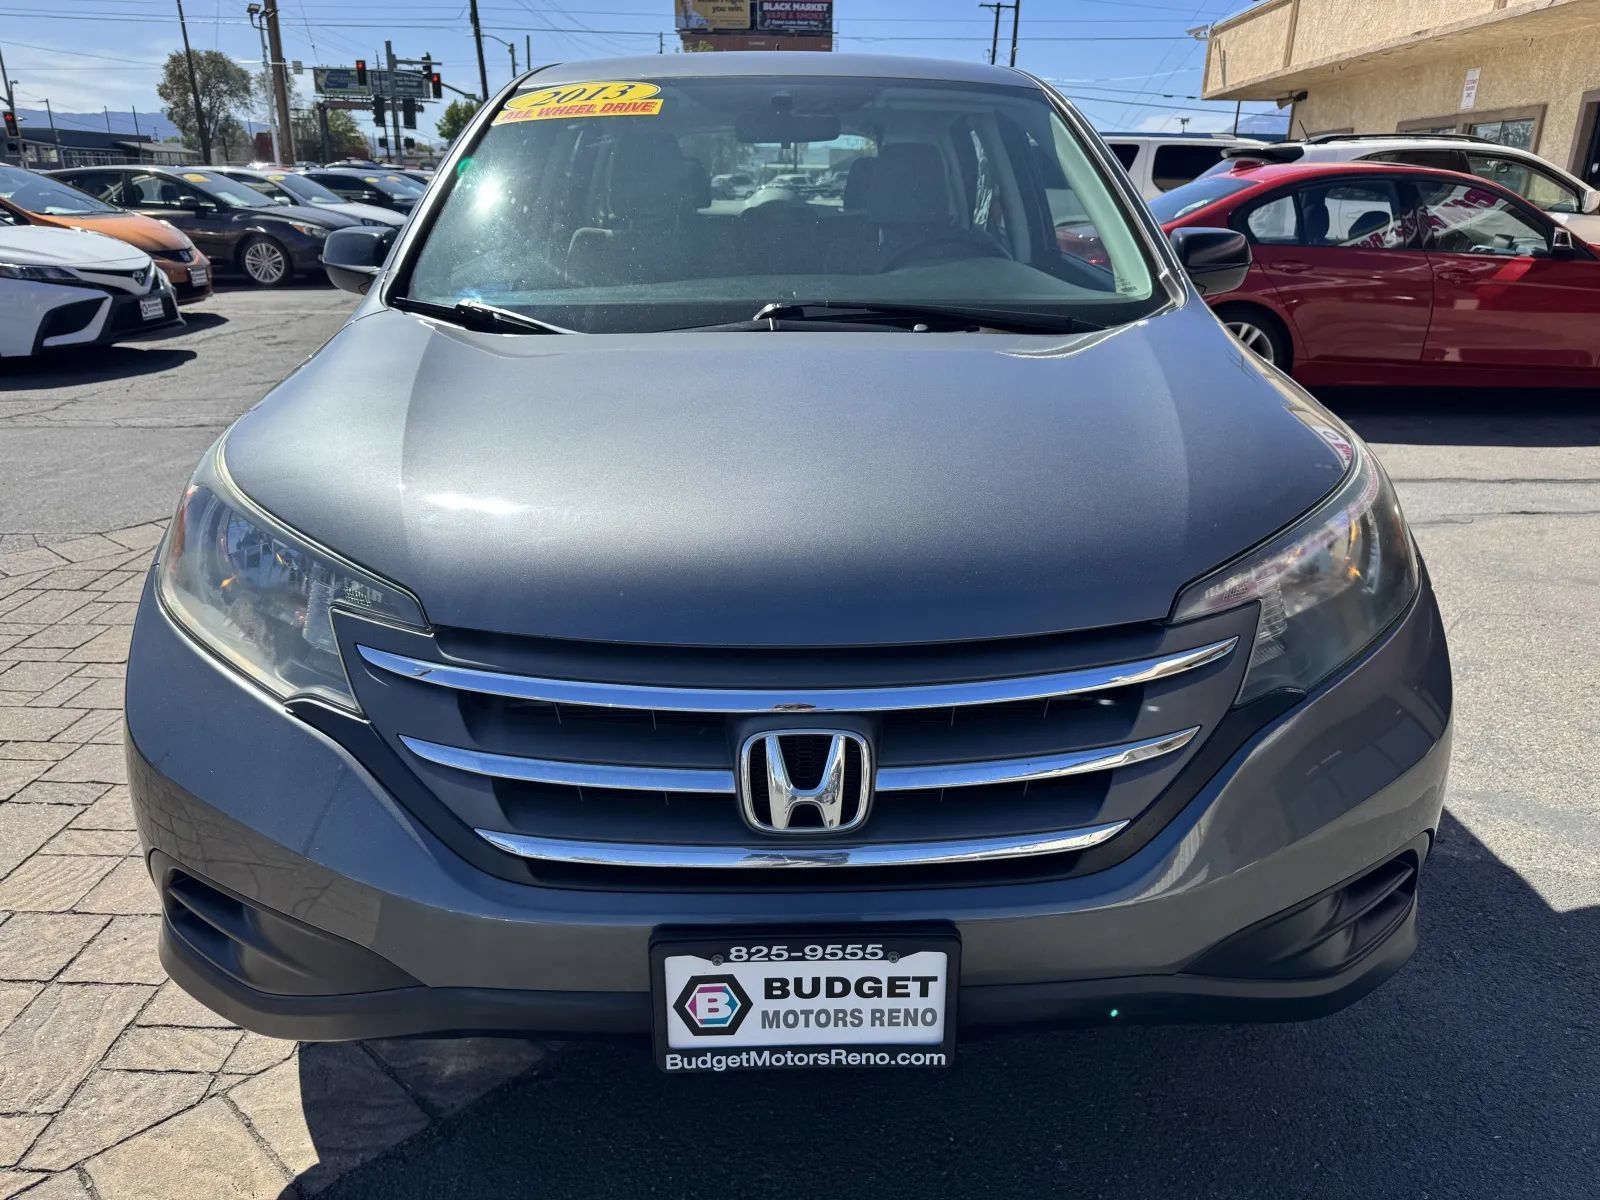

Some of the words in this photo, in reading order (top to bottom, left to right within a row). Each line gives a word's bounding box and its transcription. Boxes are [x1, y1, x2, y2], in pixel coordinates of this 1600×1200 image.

[762, 2, 791, 11] BLACK
[792, 3, 828, 12] MARKET
[765, 11, 787, 19] VAPE
[796, 12, 824, 20] SMOKE
[527, 84, 636, 108] 2013
[501, 108, 534, 121] ALL
[537, 102, 597, 118] WHEEL
[599, 100, 658, 114] DRIVE
[729, 944, 884, 962] 825-9555
[764, 975, 938, 1000] BUDGET
[761, 1008, 864, 1029] MOTORS
[870, 1007, 938, 1028] RENO
[665, 1048, 946, 1072] BudgetMotorsReno.com
